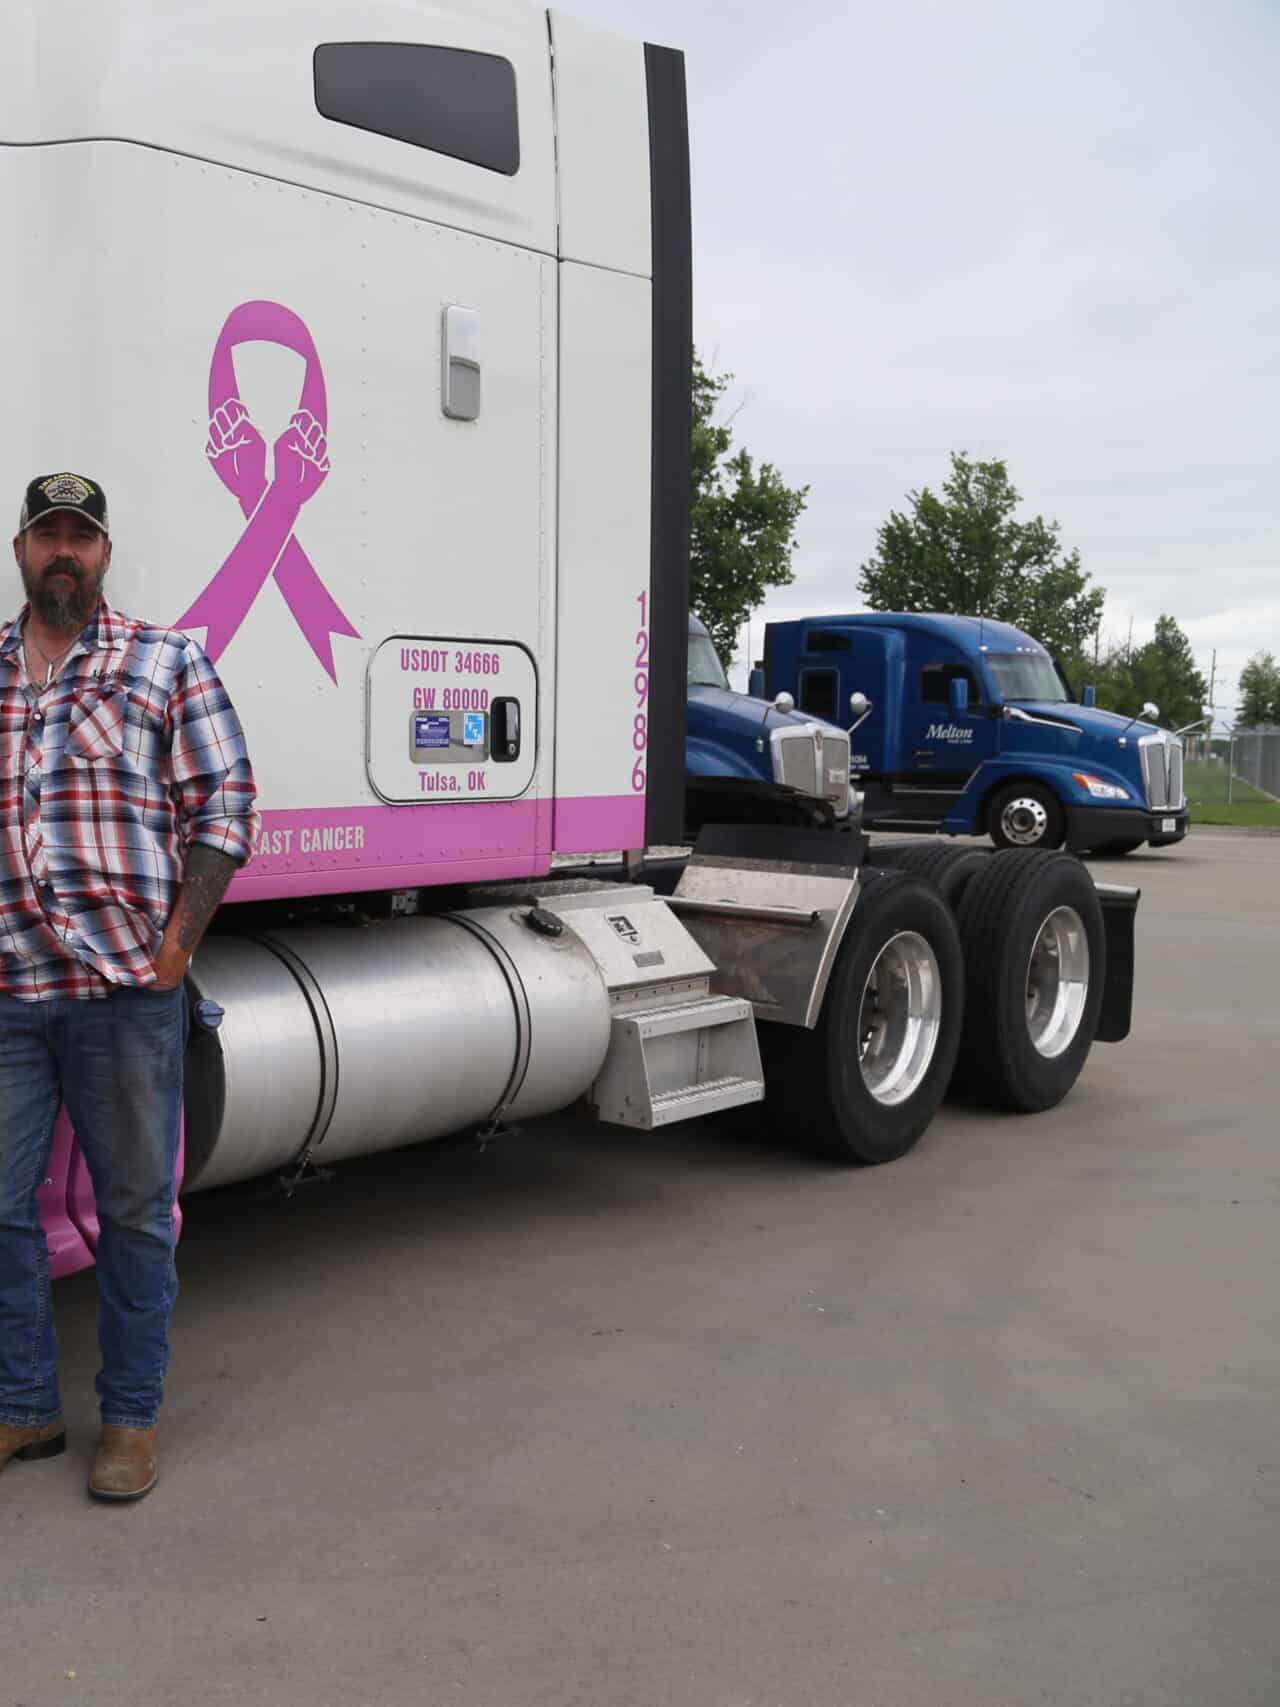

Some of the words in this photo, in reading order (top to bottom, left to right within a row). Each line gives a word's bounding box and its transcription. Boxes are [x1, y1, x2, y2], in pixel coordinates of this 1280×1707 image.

[401, 648, 449, 673] USDOT
[455, 651, 500, 675] 34666
[413, 687, 436, 710] GW
[442, 688, 489, 710] 80000
[631, 590, 649, 792] 12986
[925, 724, 974, 740] Melton
[419, 771, 461, 792] Tulsa,
[467, 771, 486, 791] OK
[300, 825, 365, 853] CANCER
